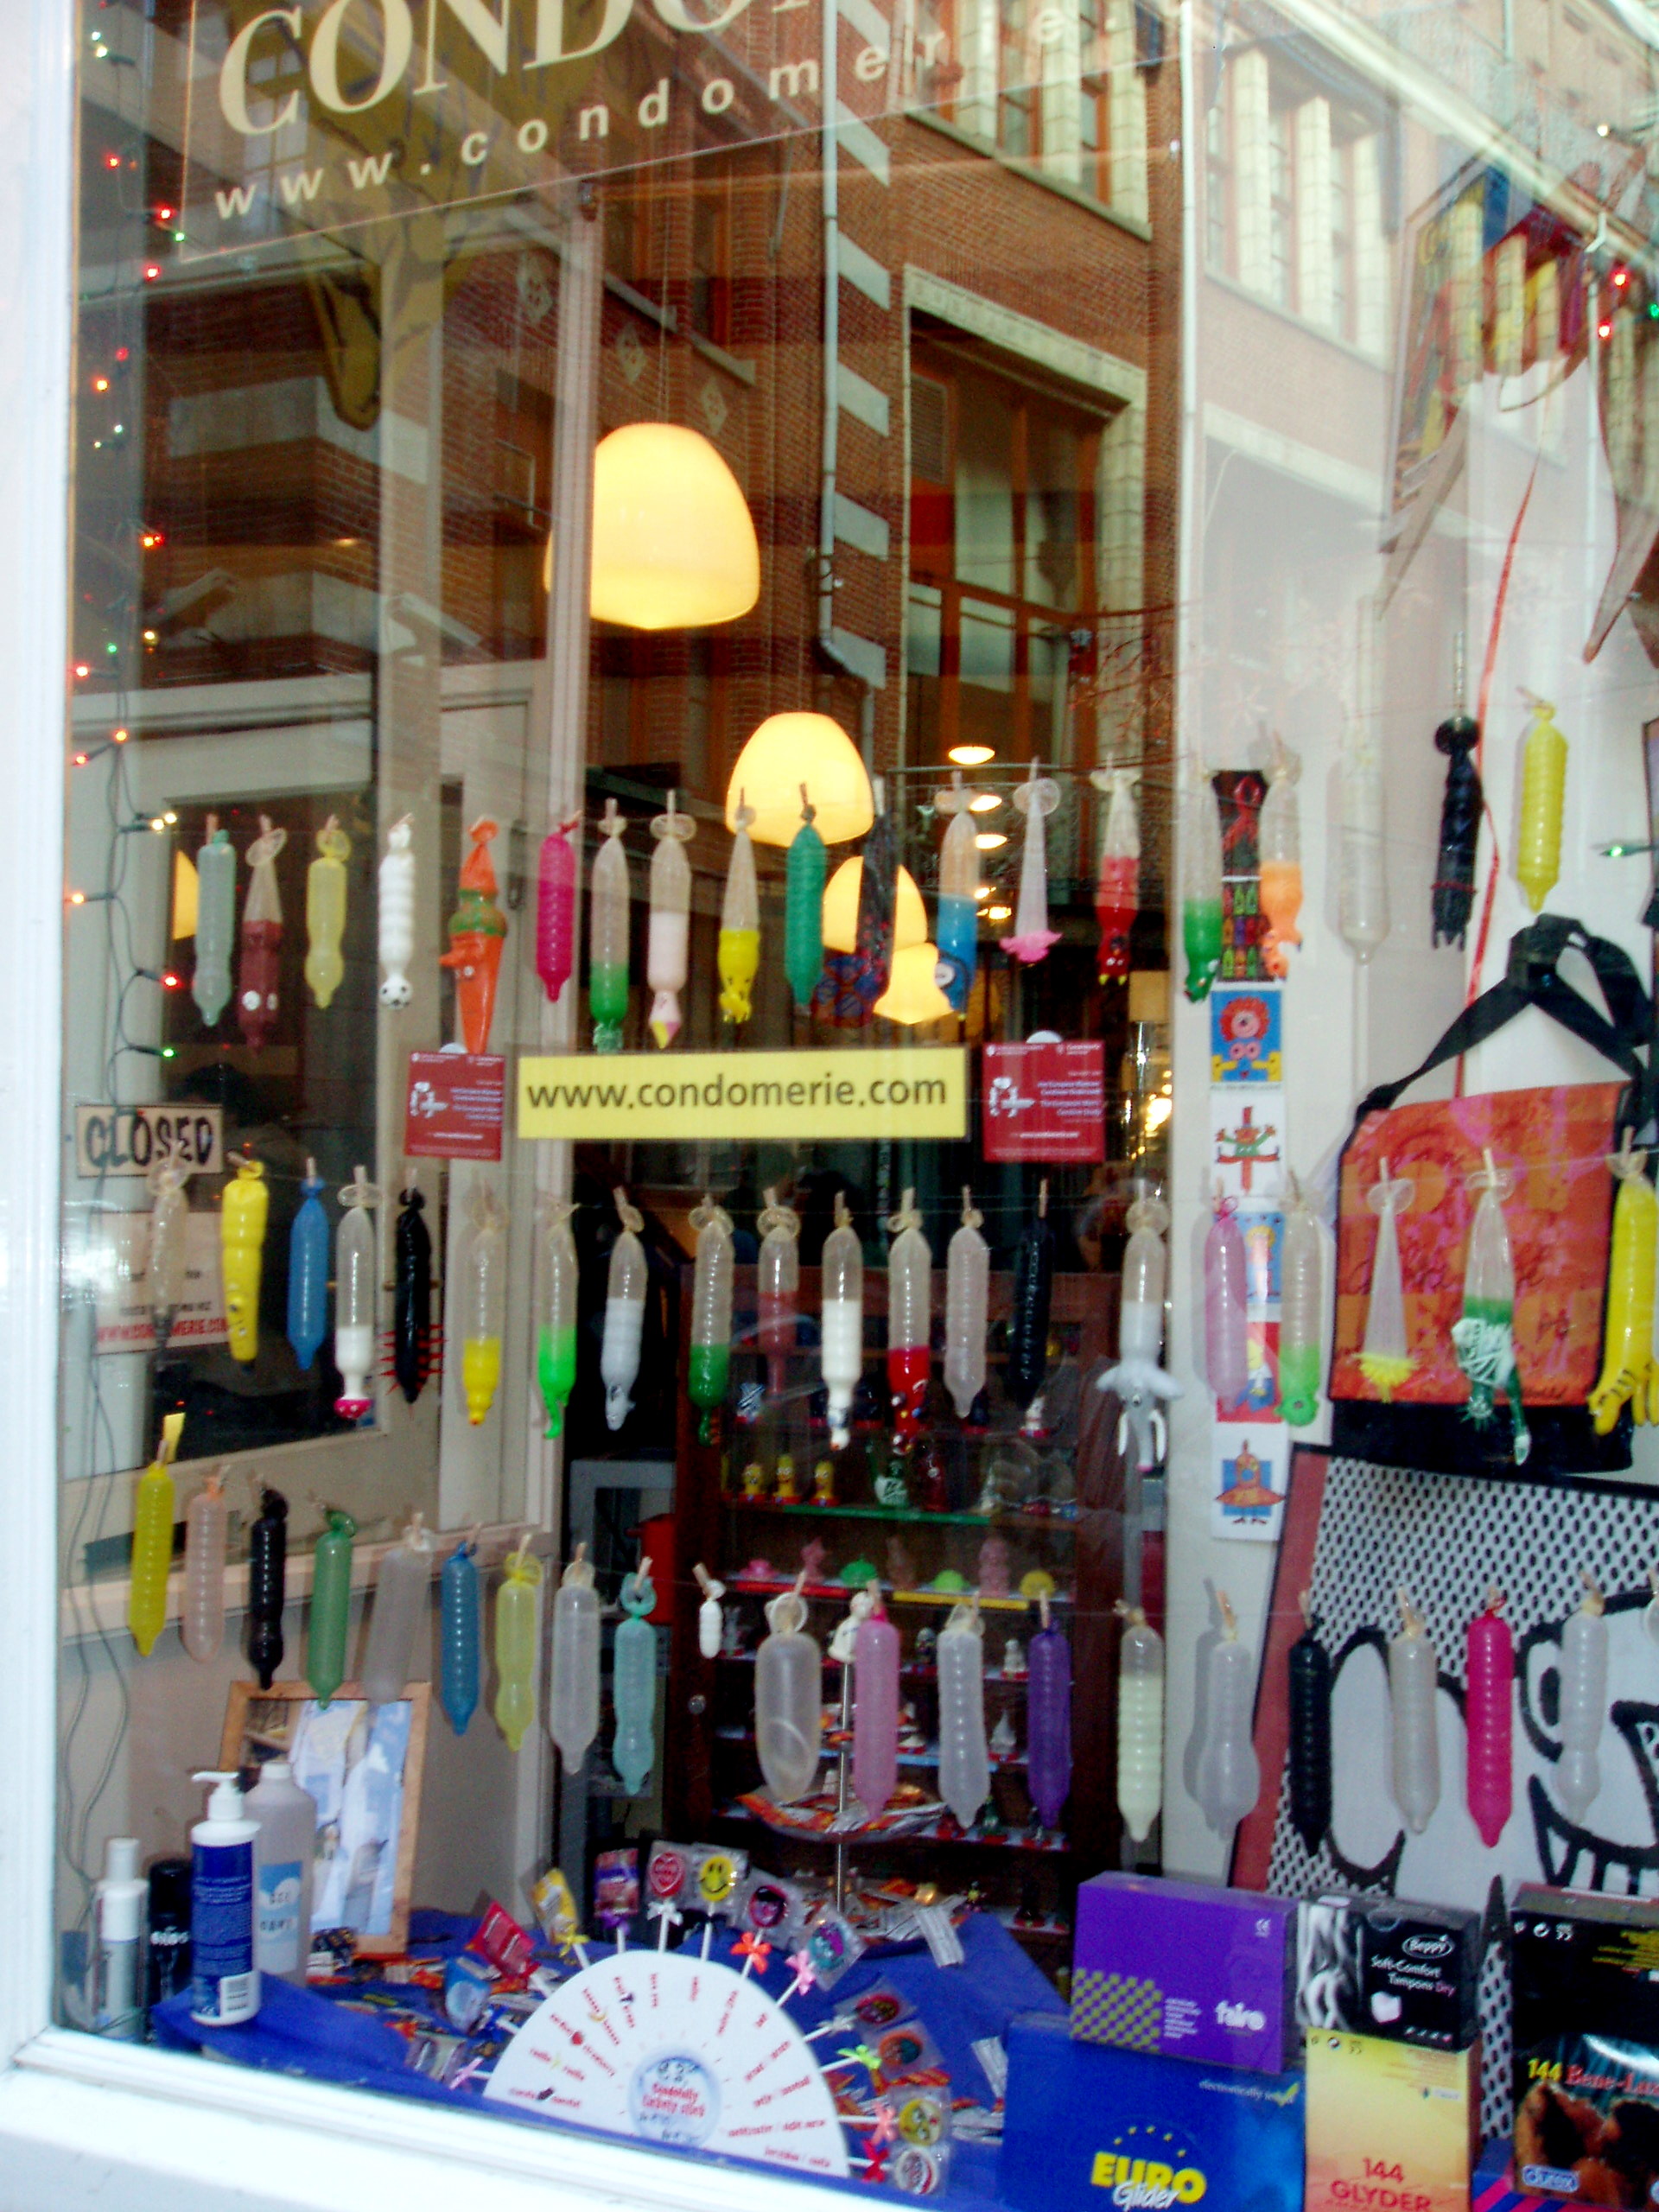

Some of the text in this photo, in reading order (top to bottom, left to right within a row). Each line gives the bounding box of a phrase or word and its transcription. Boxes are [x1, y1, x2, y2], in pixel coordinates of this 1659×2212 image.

[527, 1072, 947, 1109] www.condomerie.com
[86, 1116, 213, 1166] CLOSED
[1528, 2057, 1563, 2083] 144
[1090, 2151, 1207, 2204] EURO
[1363, 2157, 1405, 2183] 144
[1112, 2179, 1181, 2212] Glider
[1330, 2180, 1432, 2212] GLYDER
